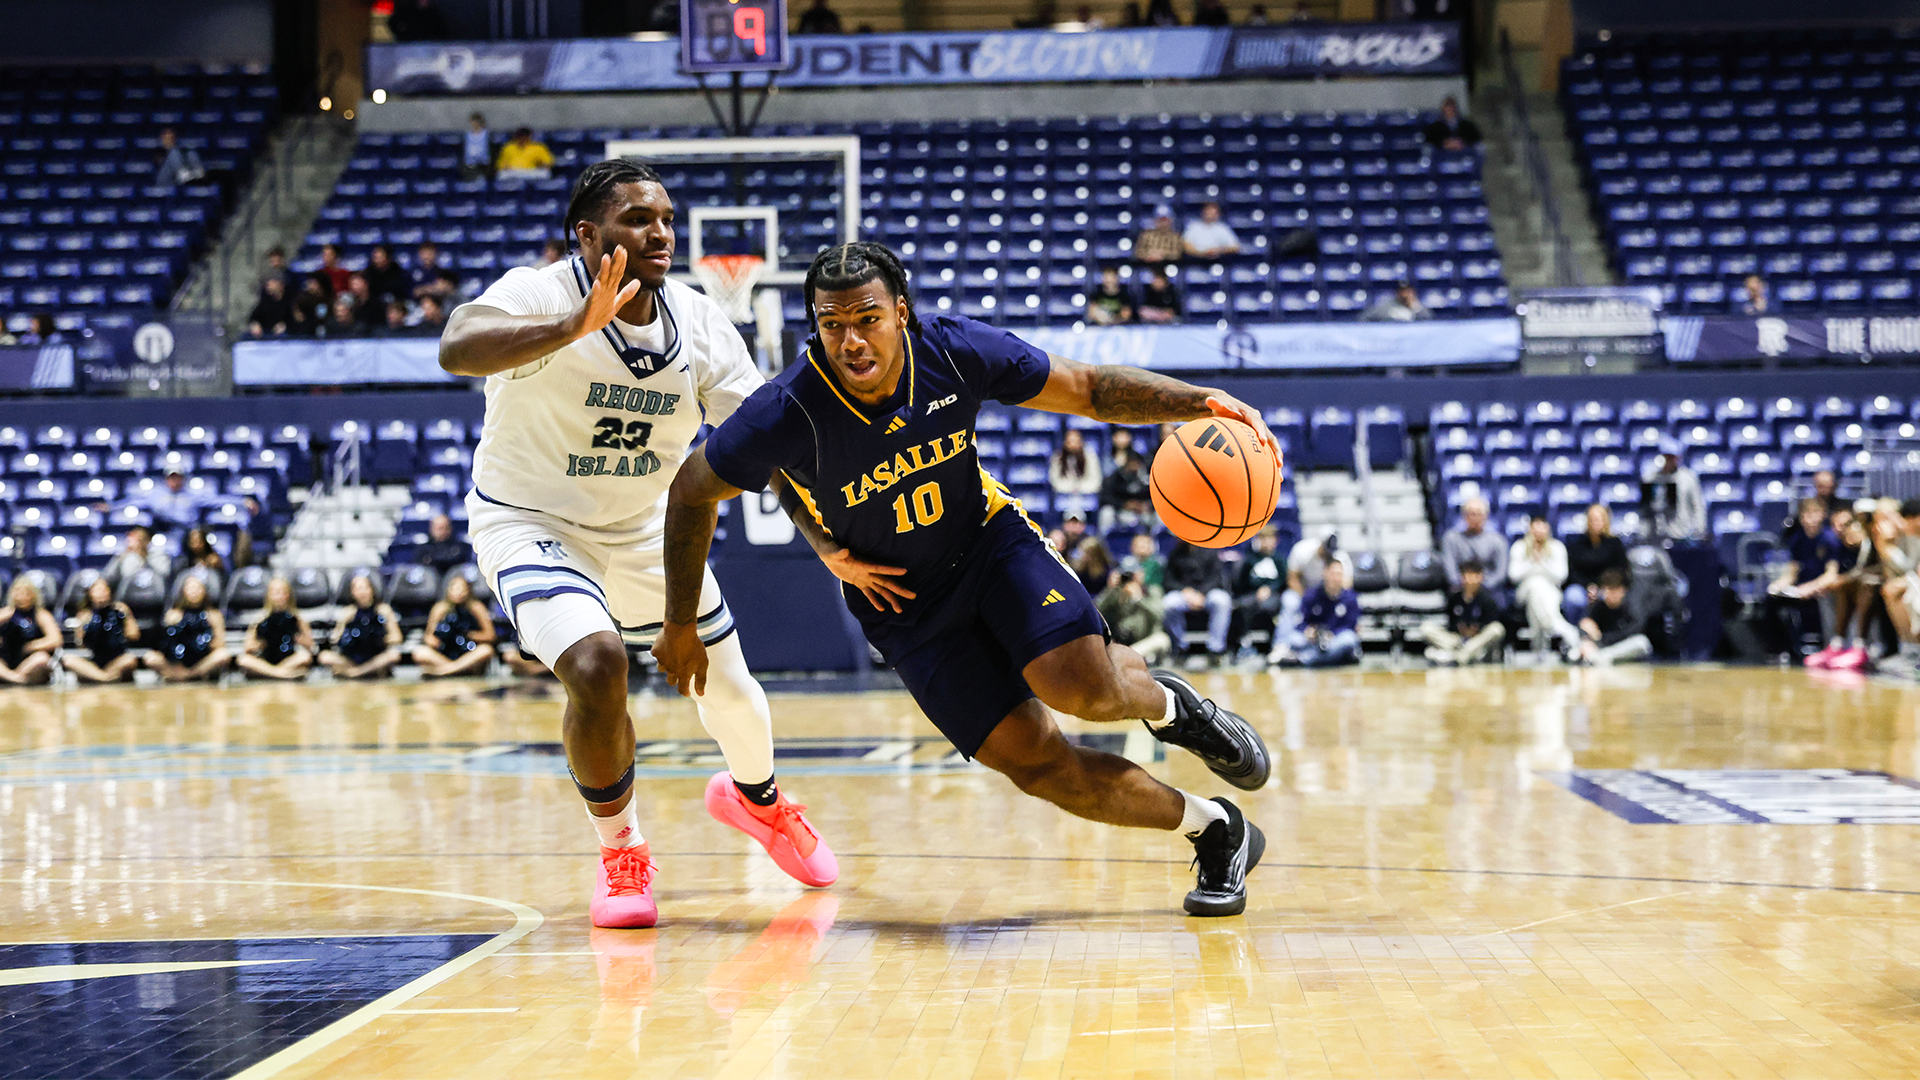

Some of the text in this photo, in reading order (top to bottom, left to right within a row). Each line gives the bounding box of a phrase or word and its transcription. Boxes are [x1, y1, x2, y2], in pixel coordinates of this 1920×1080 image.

[733, 7, 766, 56] 9
[585, 382, 681, 415] RHODE
[591, 416, 653, 450] 23
[566, 450, 662, 477] ISLAND
[892, 481, 944, 534] 10
